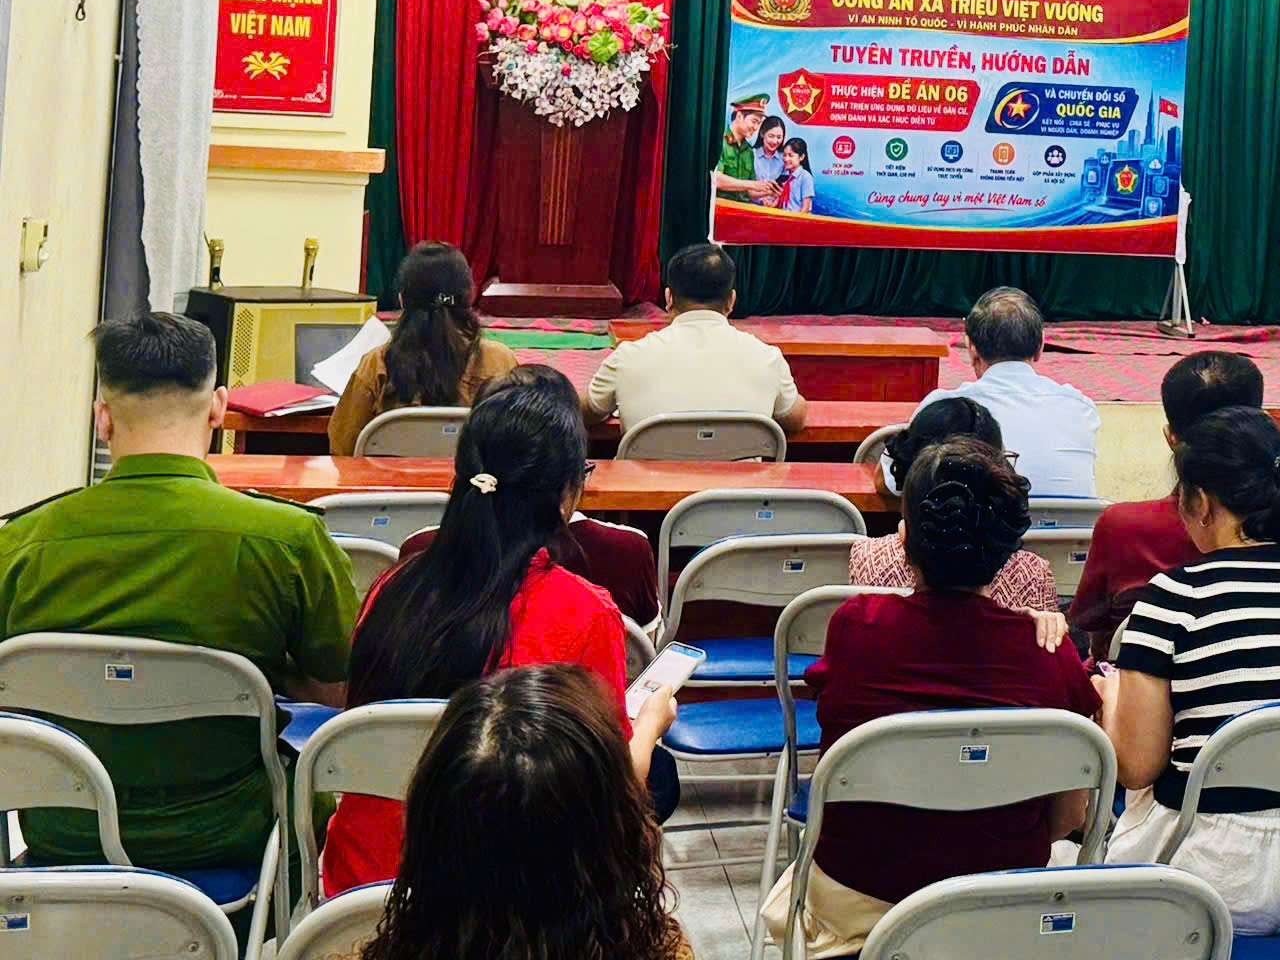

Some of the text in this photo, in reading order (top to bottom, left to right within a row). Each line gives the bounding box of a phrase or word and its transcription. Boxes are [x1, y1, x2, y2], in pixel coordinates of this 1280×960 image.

[861, 15, 875, 24] AN
[878, 16, 902, 25] NINH
[1043, 0, 1104, 23] VƯƠNG
[231, 10, 311, 39] VIỆT NAM
[830, 42, 1090, 76] TUYÊN TRUYỀN, HƯỚNG DẪN
[888, 78, 911, 100] ĐỀ
[916, 80, 940, 101] ÁN
[944, 86, 968, 102] 06
[1044, 88, 1056, 99] VÀ
[1056, 100, 1121, 119] QUỐC GIA
[867, 190, 1047, 208] Cùng chung tay vì một Việt Nam số
